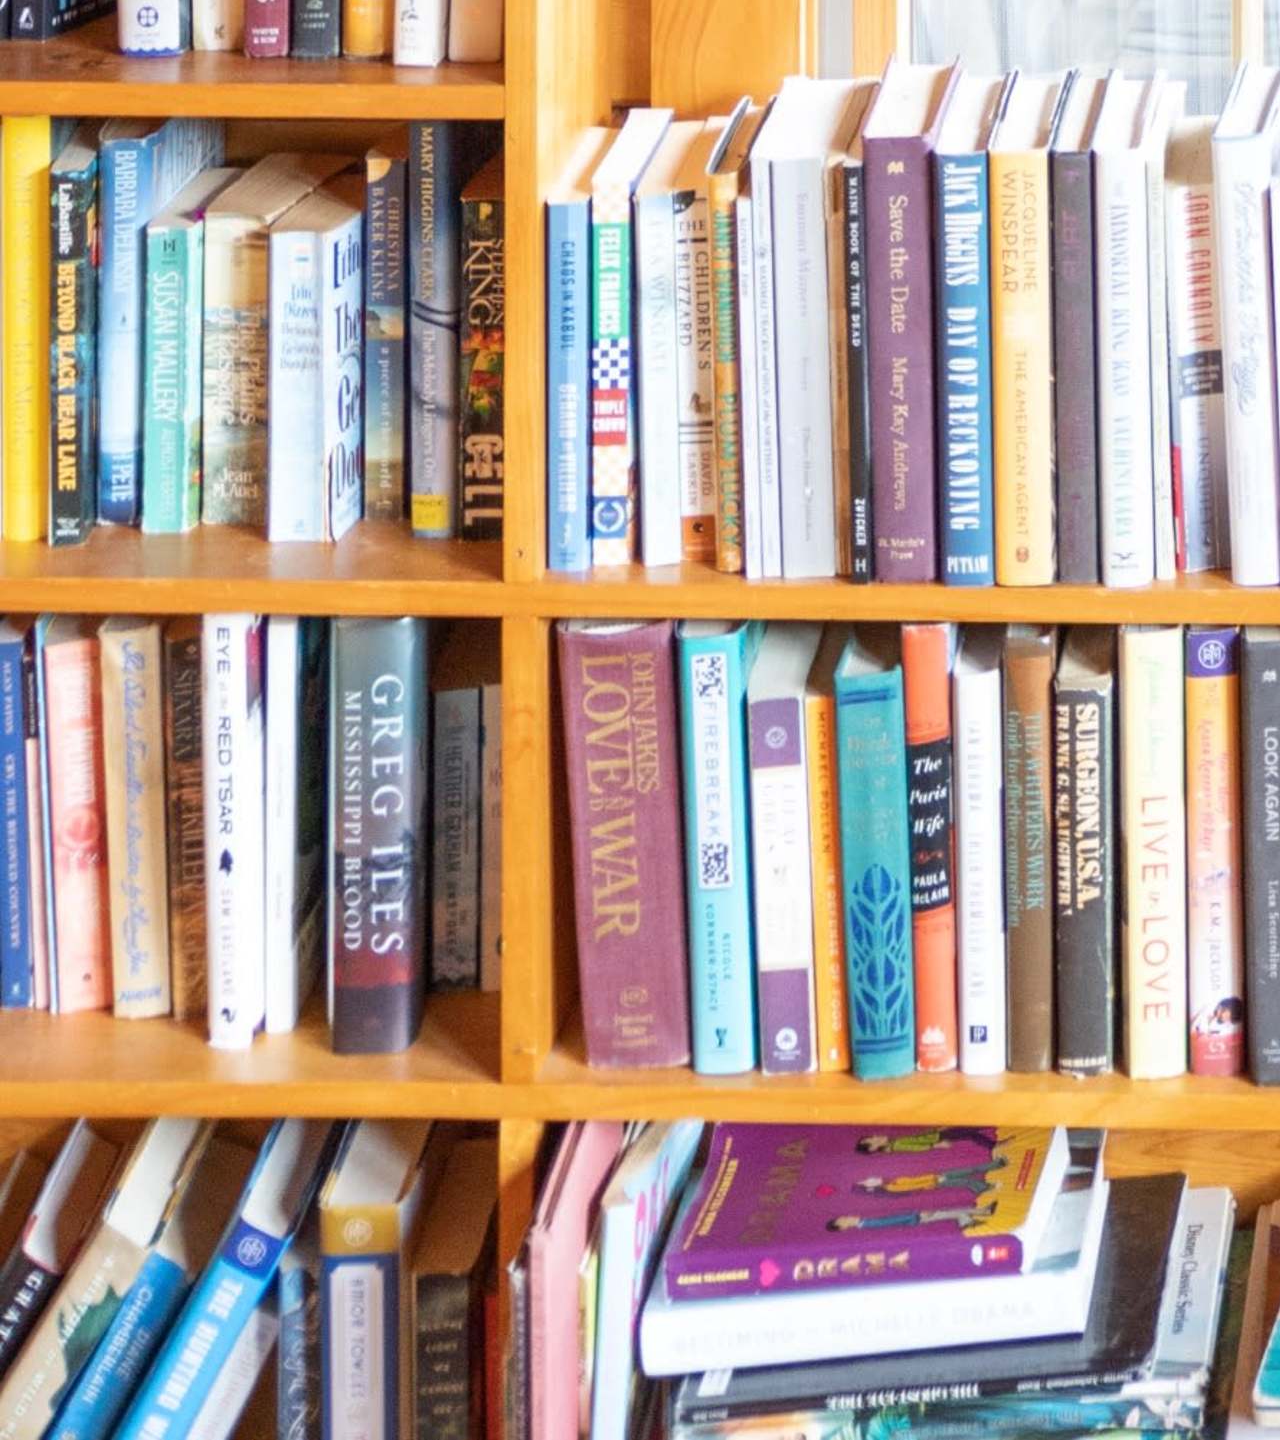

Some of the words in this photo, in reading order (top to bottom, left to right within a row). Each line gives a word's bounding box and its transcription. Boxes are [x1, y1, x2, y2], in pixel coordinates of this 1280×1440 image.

[889, 195, 910, 240] Save
[890, 245, 910, 279] the
[57, 264, 75, 331] BEYOND
[152, 270, 178, 329] SUSAN
[891, 284, 911, 335] Date
[948, 307, 979, 350] DAY
[57, 334, 76, 383] BLACK
[153, 331, 179, 423] MALLERY
[948, 359, 980, 388] OF
[57, 387, 76, 430] BEAR
[57, 443, 76, 492] LAKE
[948, 392, 980, 530] RECKONING
[370, 675, 405, 818] GREG
[582, 653, 635, 790] LOVE
[343, 691, 362, 848] MISSISSIPPI
[1264, 726, 1280, 778] LOOK
[1265, 782, 1280, 842] AGAIN
[344, 858, 362, 952] BLOOD
[371, 843, 405, 955] ILES
[591, 814, 643, 942] WAR
[793, 1250, 911, 1281] DRAMA
